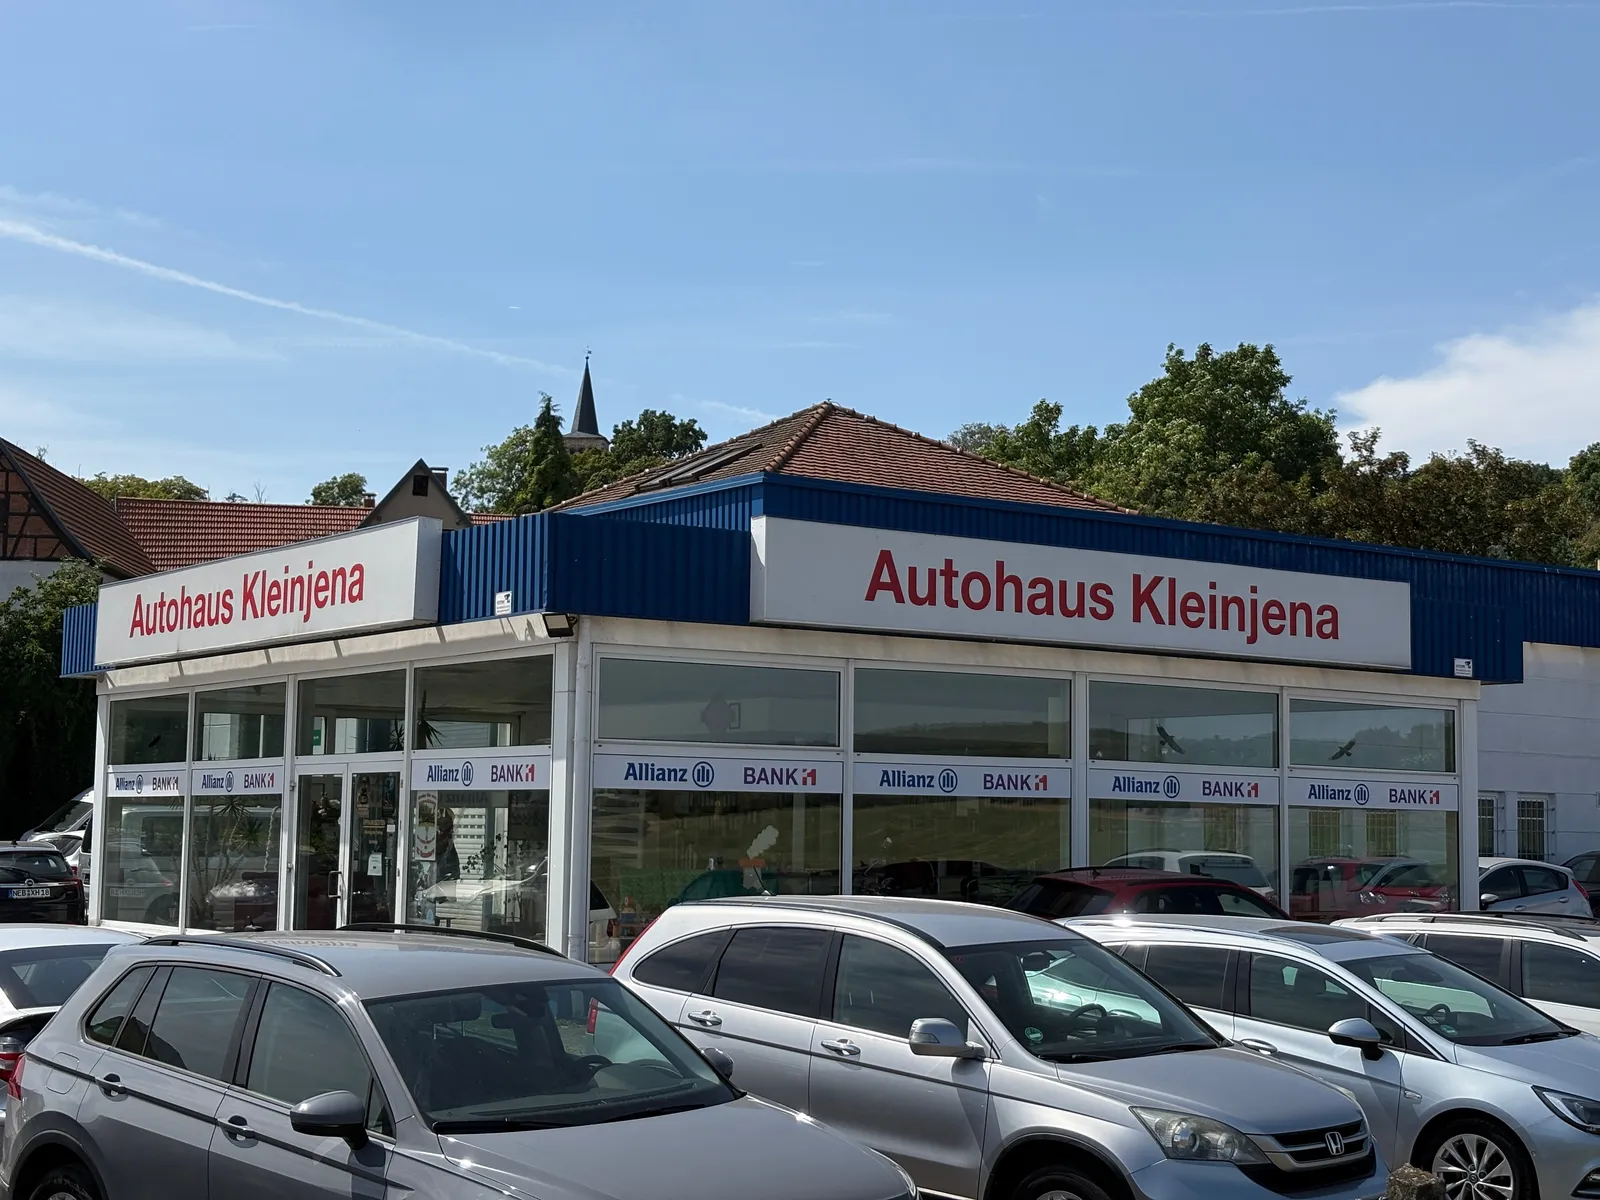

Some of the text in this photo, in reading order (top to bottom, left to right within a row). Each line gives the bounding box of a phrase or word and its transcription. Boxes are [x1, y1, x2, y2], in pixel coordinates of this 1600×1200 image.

[129, 561, 364, 637] Autohaus Kleinjena
[865, 549, 1339, 644] Autohaus Kleinjena
[201, 774, 225, 789] Allianz
[426, 764, 460, 783] Allianz
[624, 762, 688, 782] Allianz
[880, 768, 935, 788] Allianz
[115, 777, 136, 791] Allianz
[1112, 776, 1160, 793] Allianz
[1308, 783, 1351, 801] Allianz
